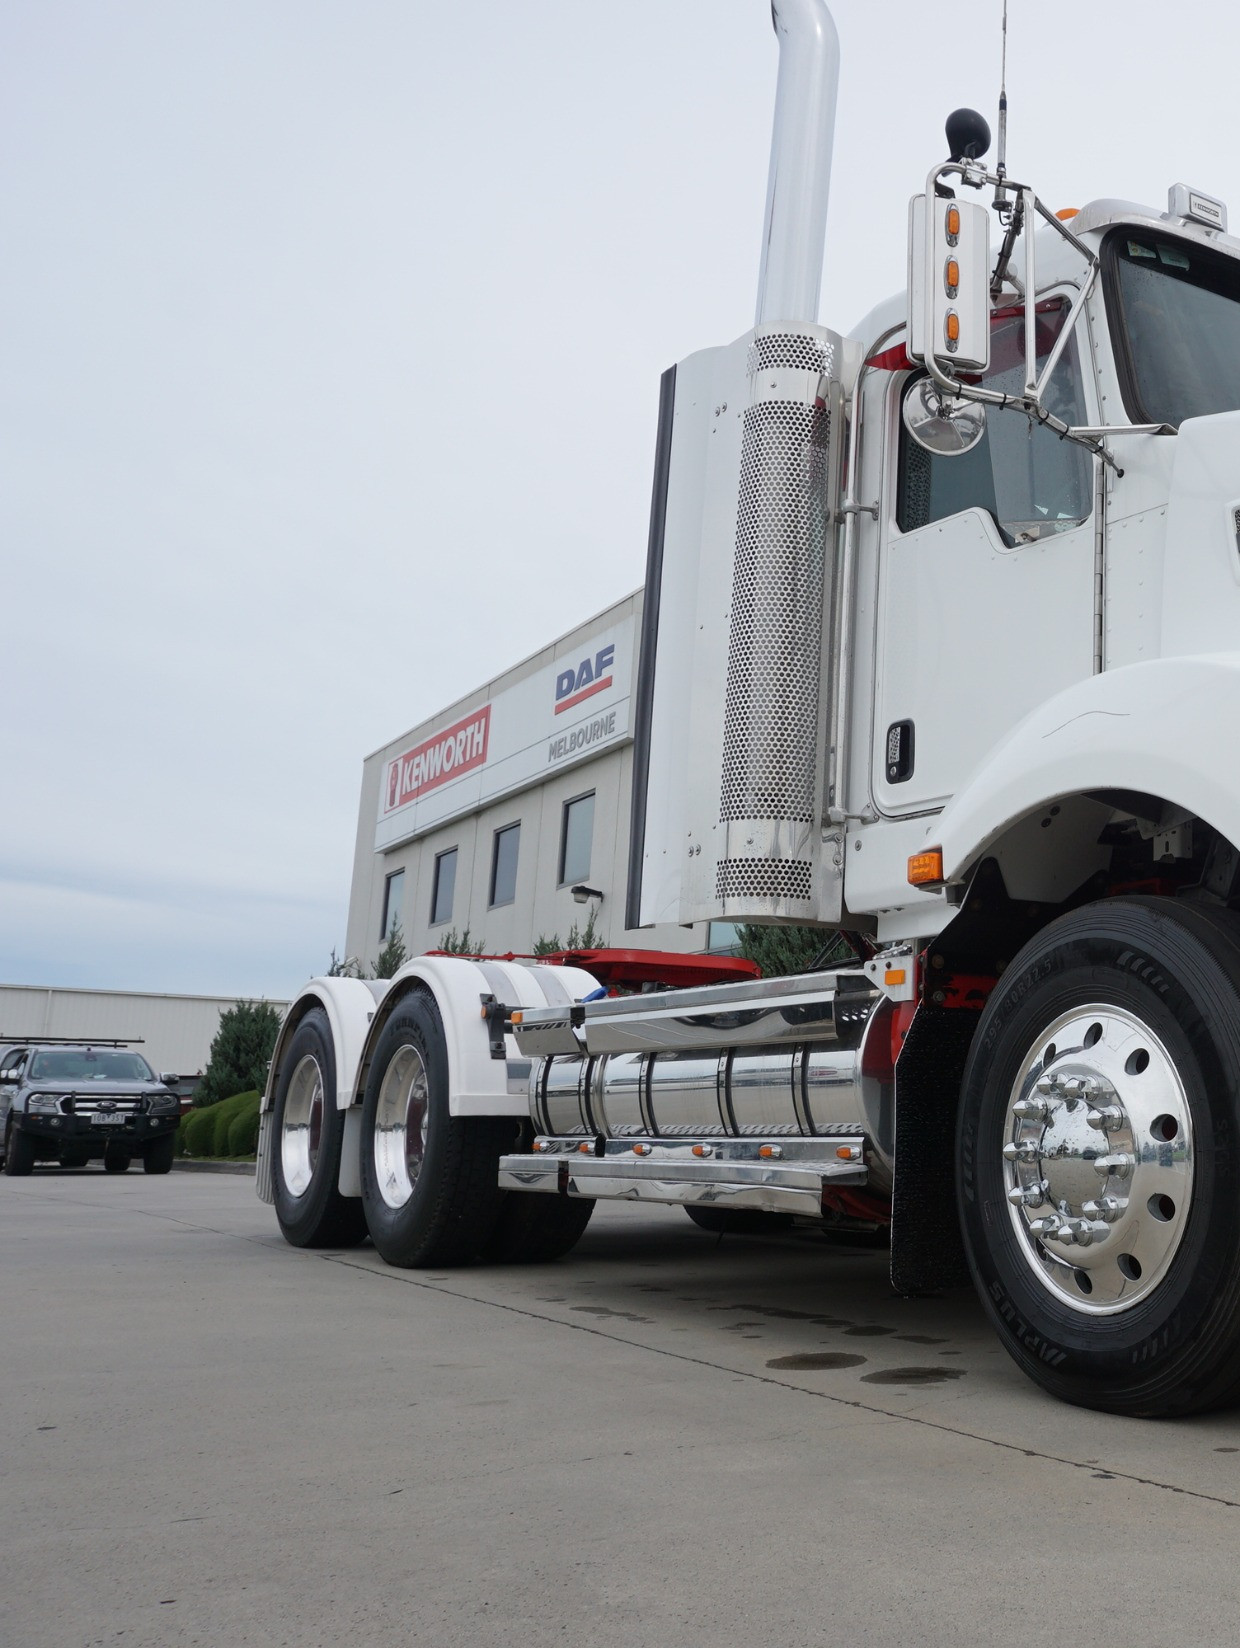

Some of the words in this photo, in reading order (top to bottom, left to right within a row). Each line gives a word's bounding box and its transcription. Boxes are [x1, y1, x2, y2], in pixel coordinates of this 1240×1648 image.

[555, 644, 615, 701] DAF
[401, 717, 486, 796] KENWORTH
[548, 711, 616, 762] MELBOURNE
[988, 1280, 1068, 1367] APLUS
